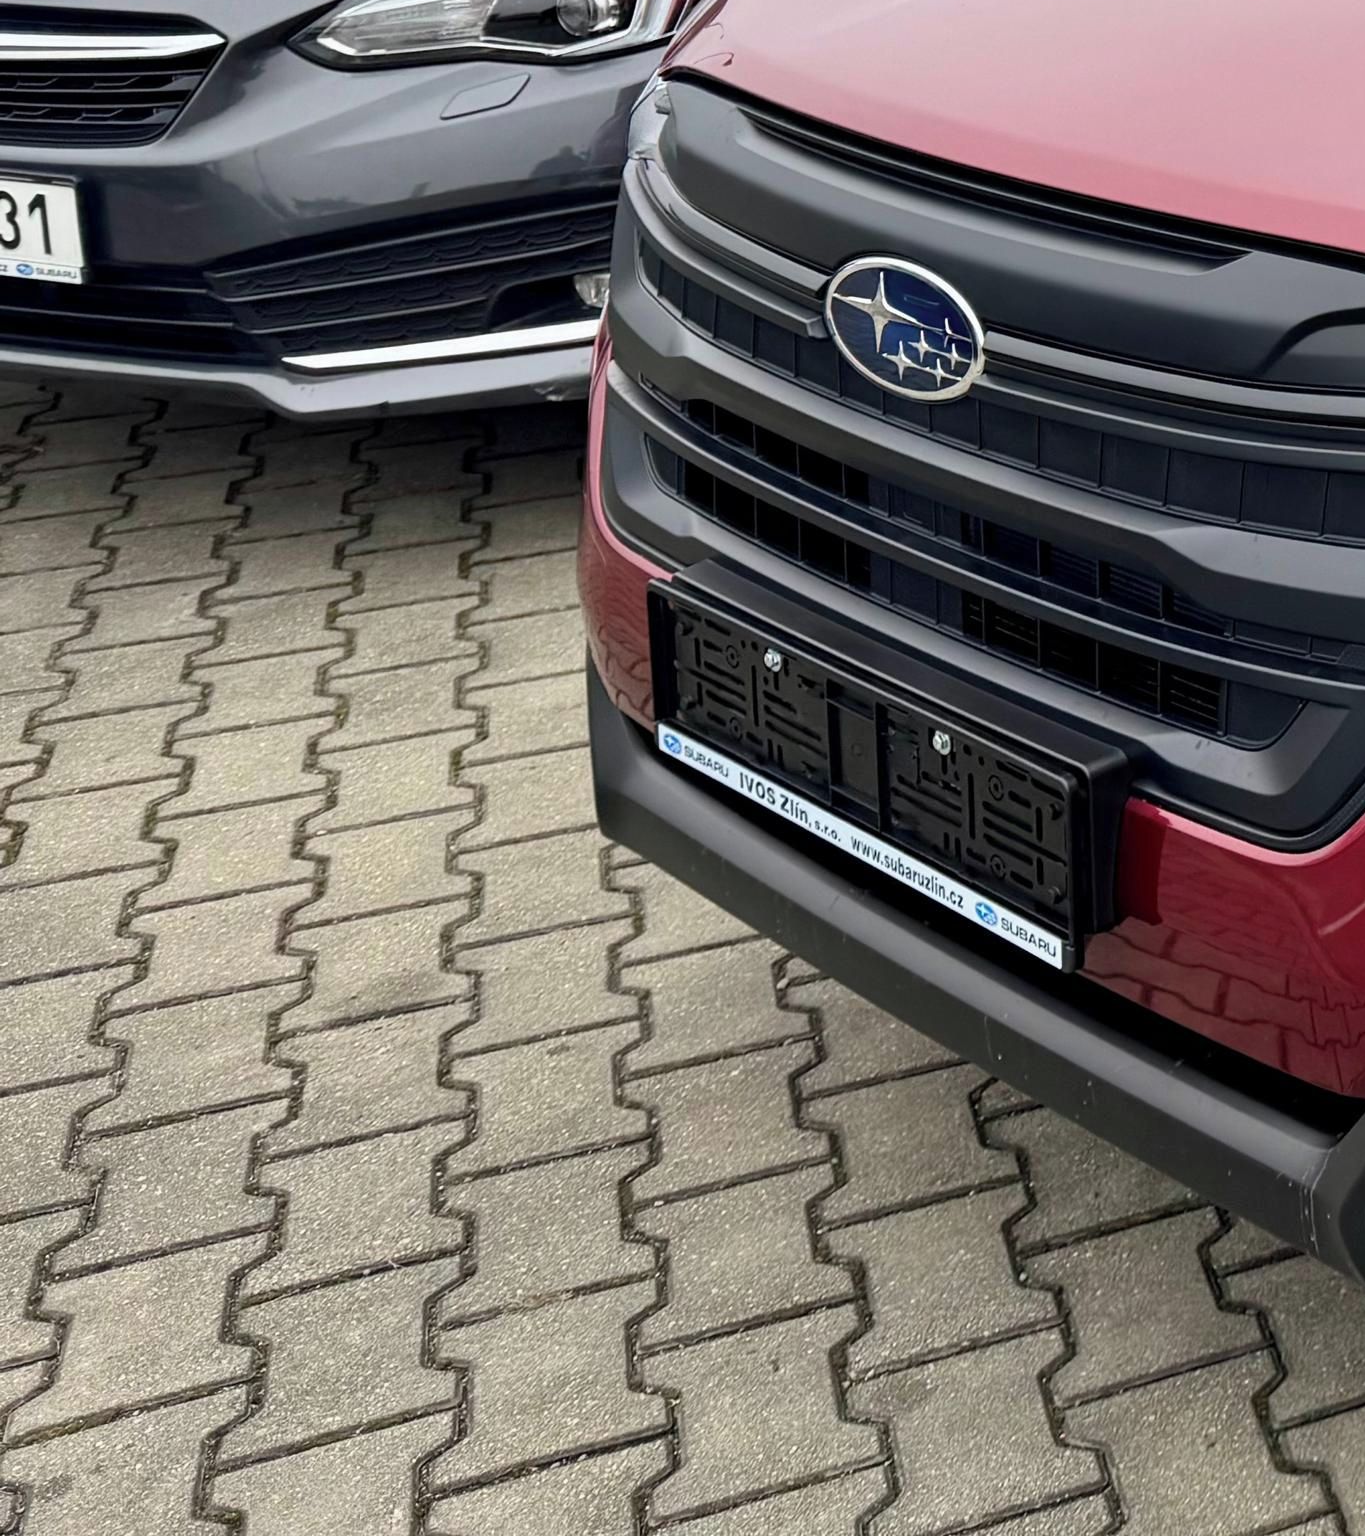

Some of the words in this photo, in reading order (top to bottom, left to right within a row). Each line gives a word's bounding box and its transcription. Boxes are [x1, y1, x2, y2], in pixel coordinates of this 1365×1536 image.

[683, 744, 730, 778] SUBARU
[738, 771, 776, 806] IVOS
[813, 818, 842, 843] s.r.o.
[850, 835, 965, 910] www.subaruzlin.cz
[1000, 916, 1058, 958] SUBARU
